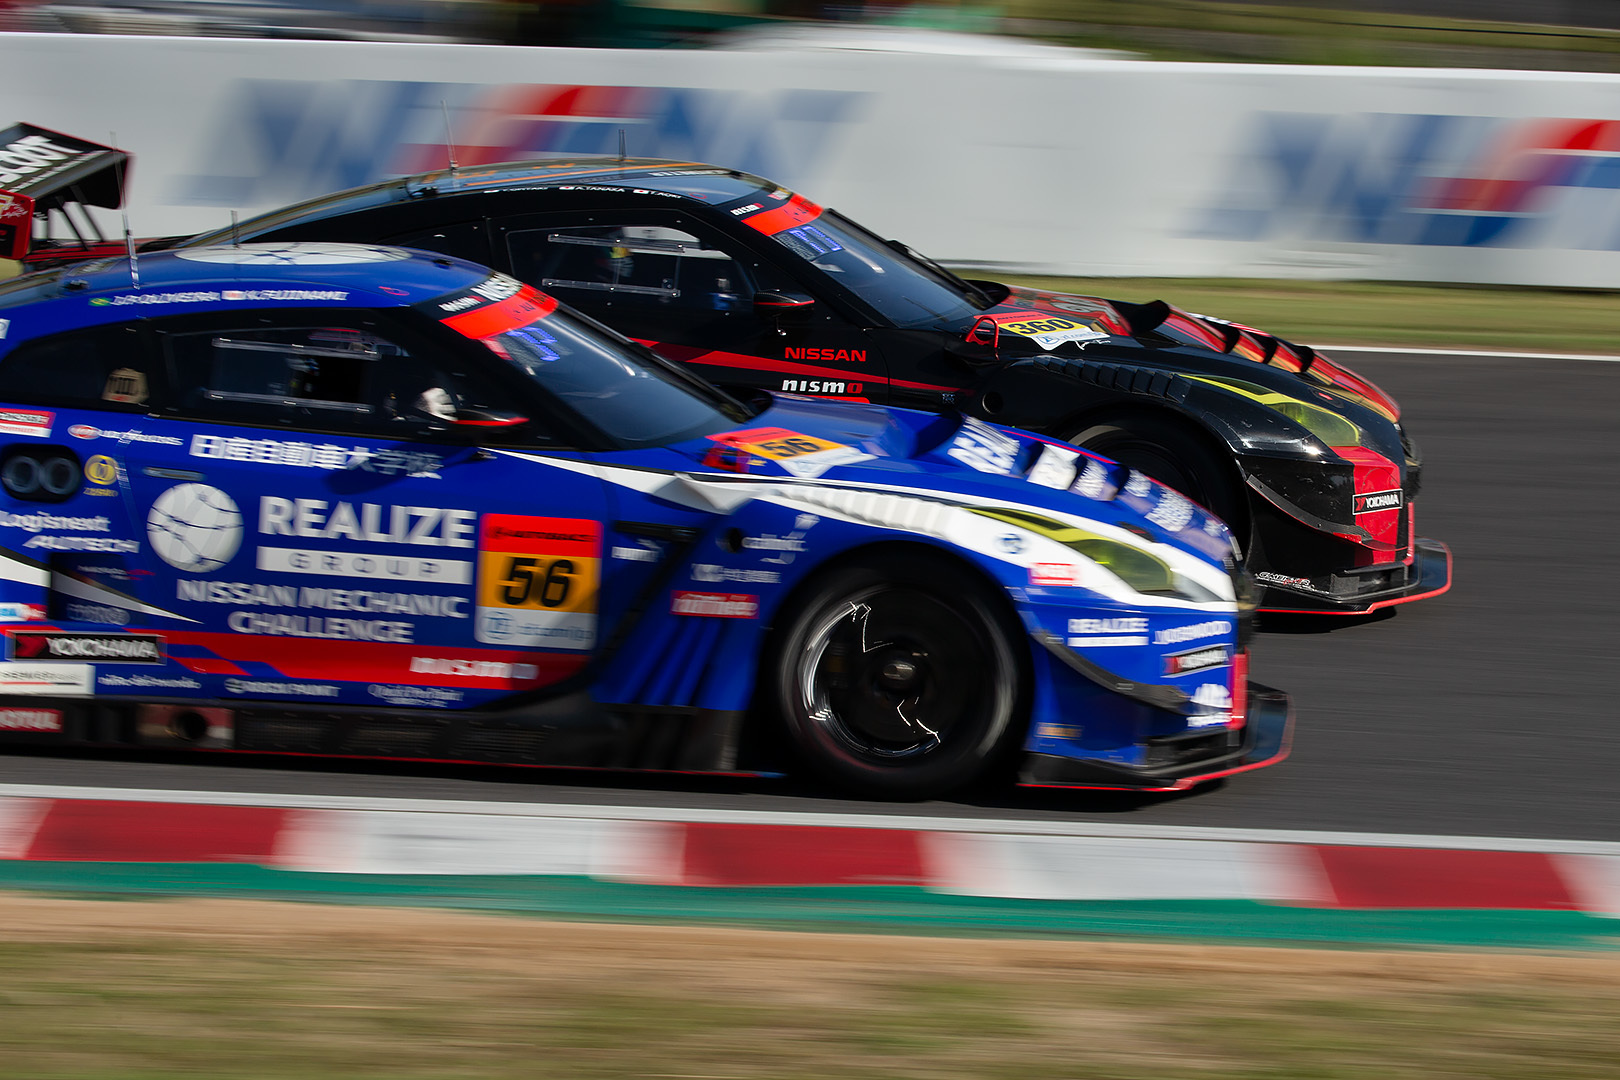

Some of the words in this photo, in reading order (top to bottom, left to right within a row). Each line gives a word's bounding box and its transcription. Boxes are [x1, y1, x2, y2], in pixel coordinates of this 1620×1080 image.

[1008, 318, 1075, 335] 360
[785, 347, 866, 361] NISSAN
[782, 380, 863, 394] nismo
[760, 437, 822, 458] 56
[1365, 493, 1400, 509] YOKOHAMA
[258, 495, 478, 548] REALIZE
[287, 552, 442, 578] GROUP
[500, 556, 580, 608] 56
[177, 578, 299, 607] NISSAN
[299, 586, 470, 618] MECHANIC
[227, 611, 415, 643] CHALLENGE
[46, 637, 160, 658] YOKOHAMA
